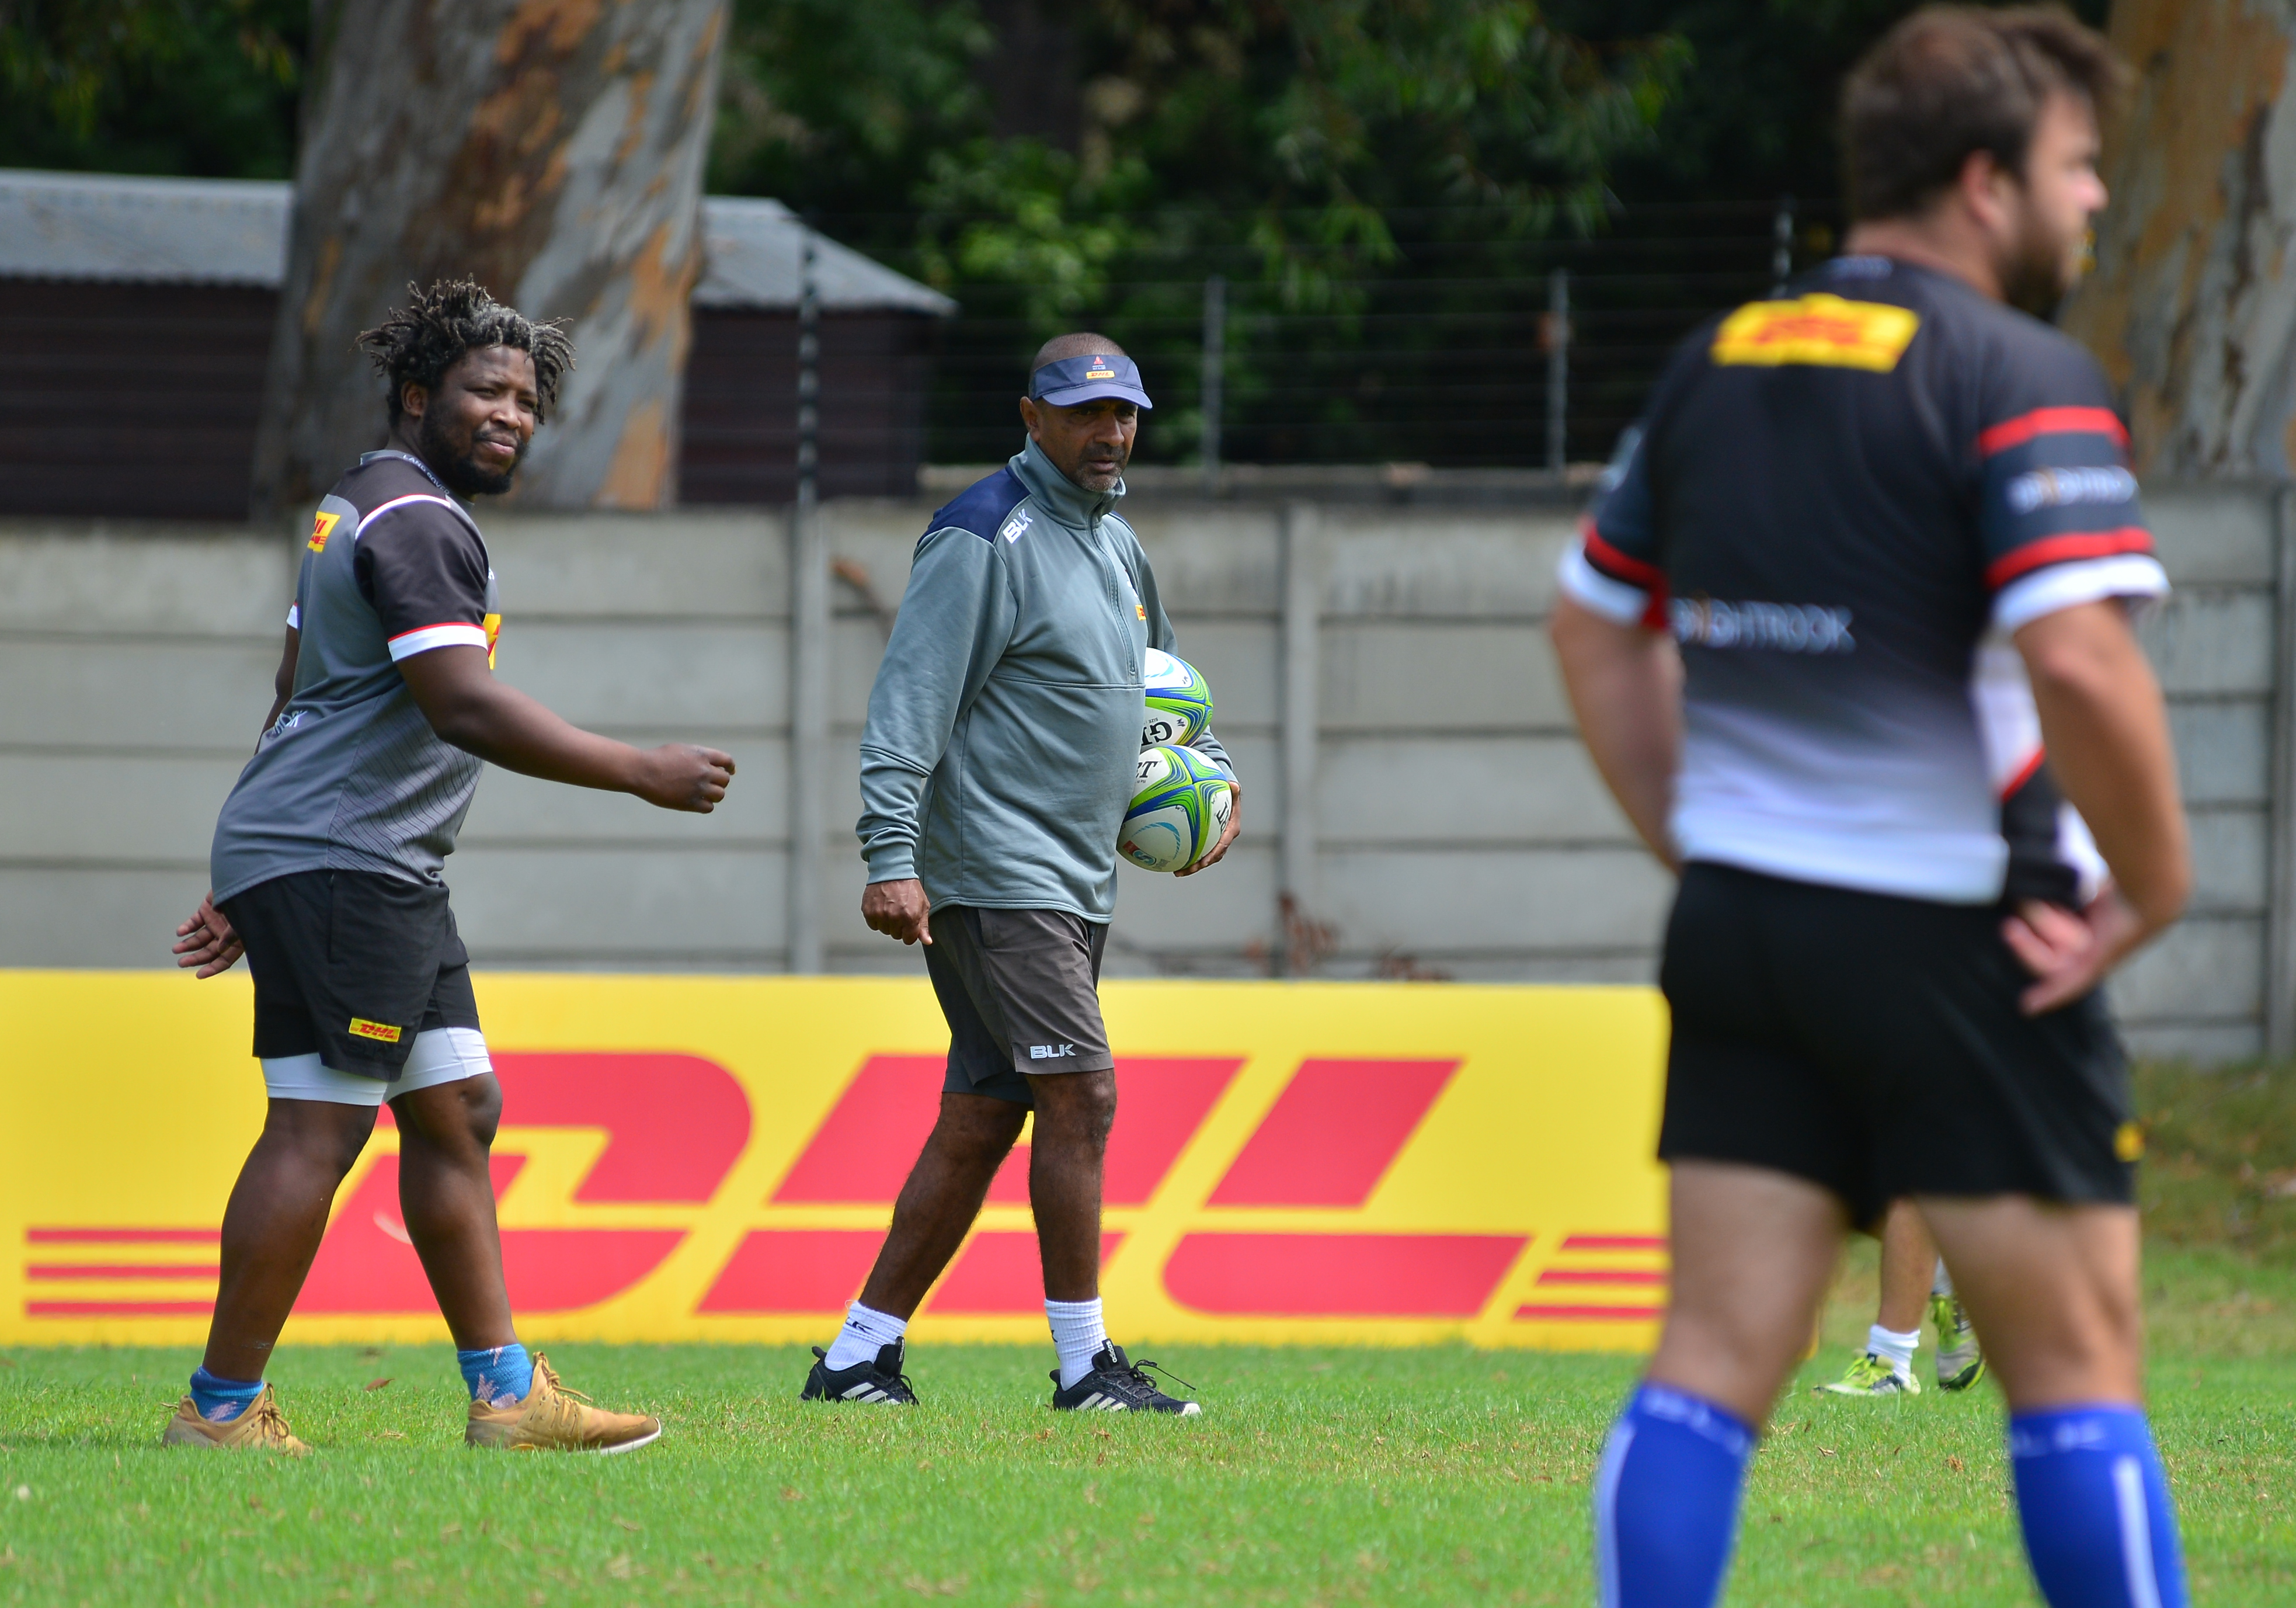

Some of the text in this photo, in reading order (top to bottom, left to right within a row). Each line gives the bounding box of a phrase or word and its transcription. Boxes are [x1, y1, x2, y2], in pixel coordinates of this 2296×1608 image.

[403, 454, 450, 495] LAND ROVER
[1003, 508, 1033, 544] BLK
[360, 1023, 394, 1039] DHL
[1030, 1044, 1076, 1059] BLK
[291, 1051, 1535, 1319] DHL
[1106, 1340, 1118, 1363] adidas
